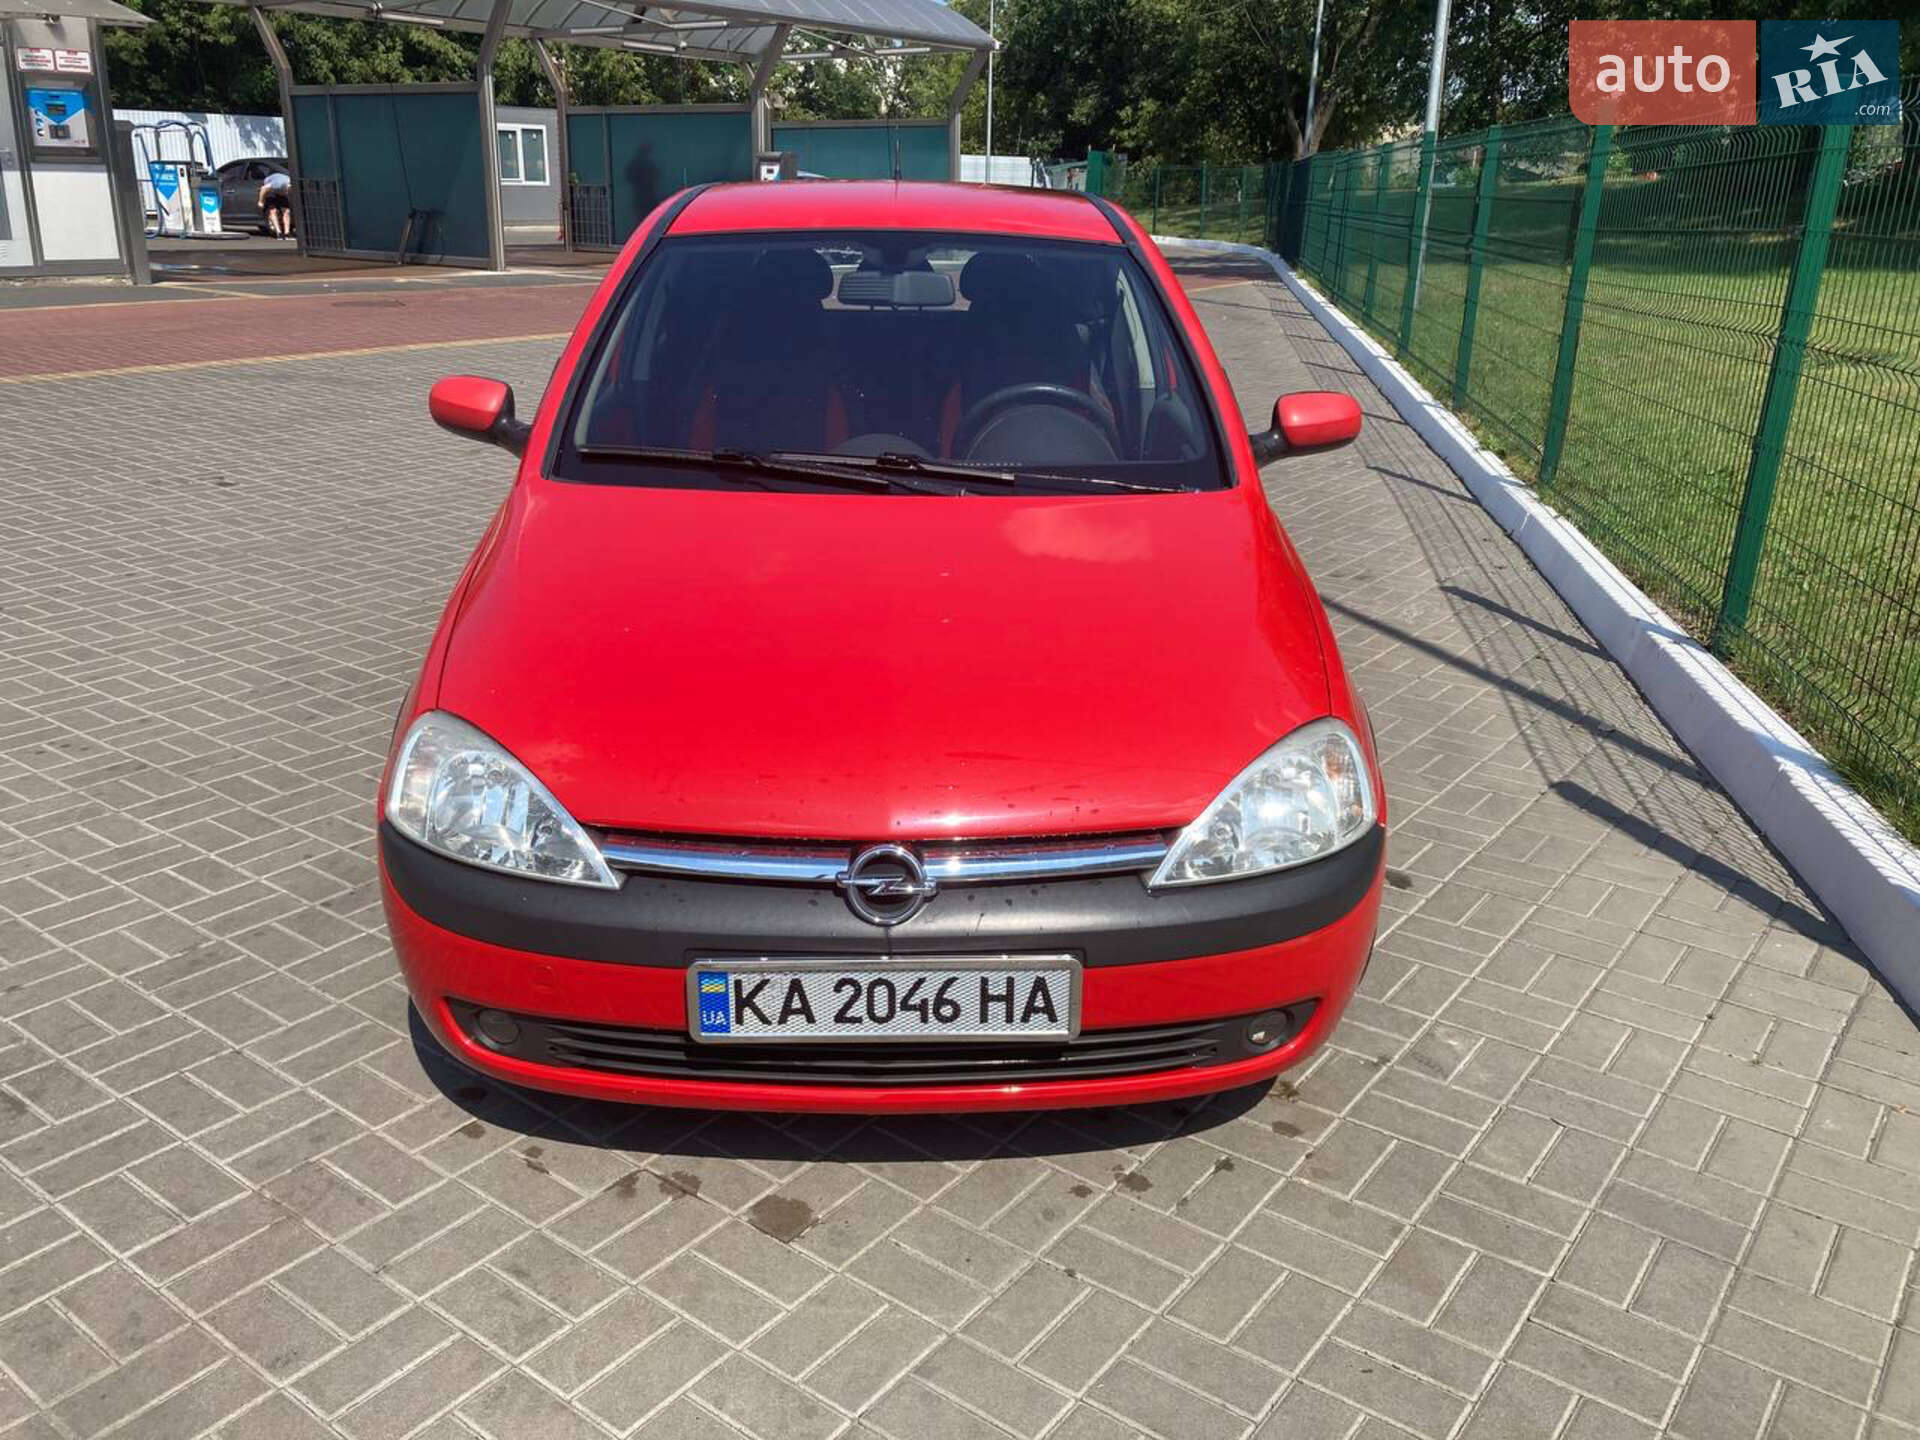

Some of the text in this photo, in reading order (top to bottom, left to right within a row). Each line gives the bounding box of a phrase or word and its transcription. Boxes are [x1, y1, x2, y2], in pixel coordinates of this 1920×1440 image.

[733, 975, 1058, 1026] KA 2046 HA
[702, 1011, 726, 1026] UA
